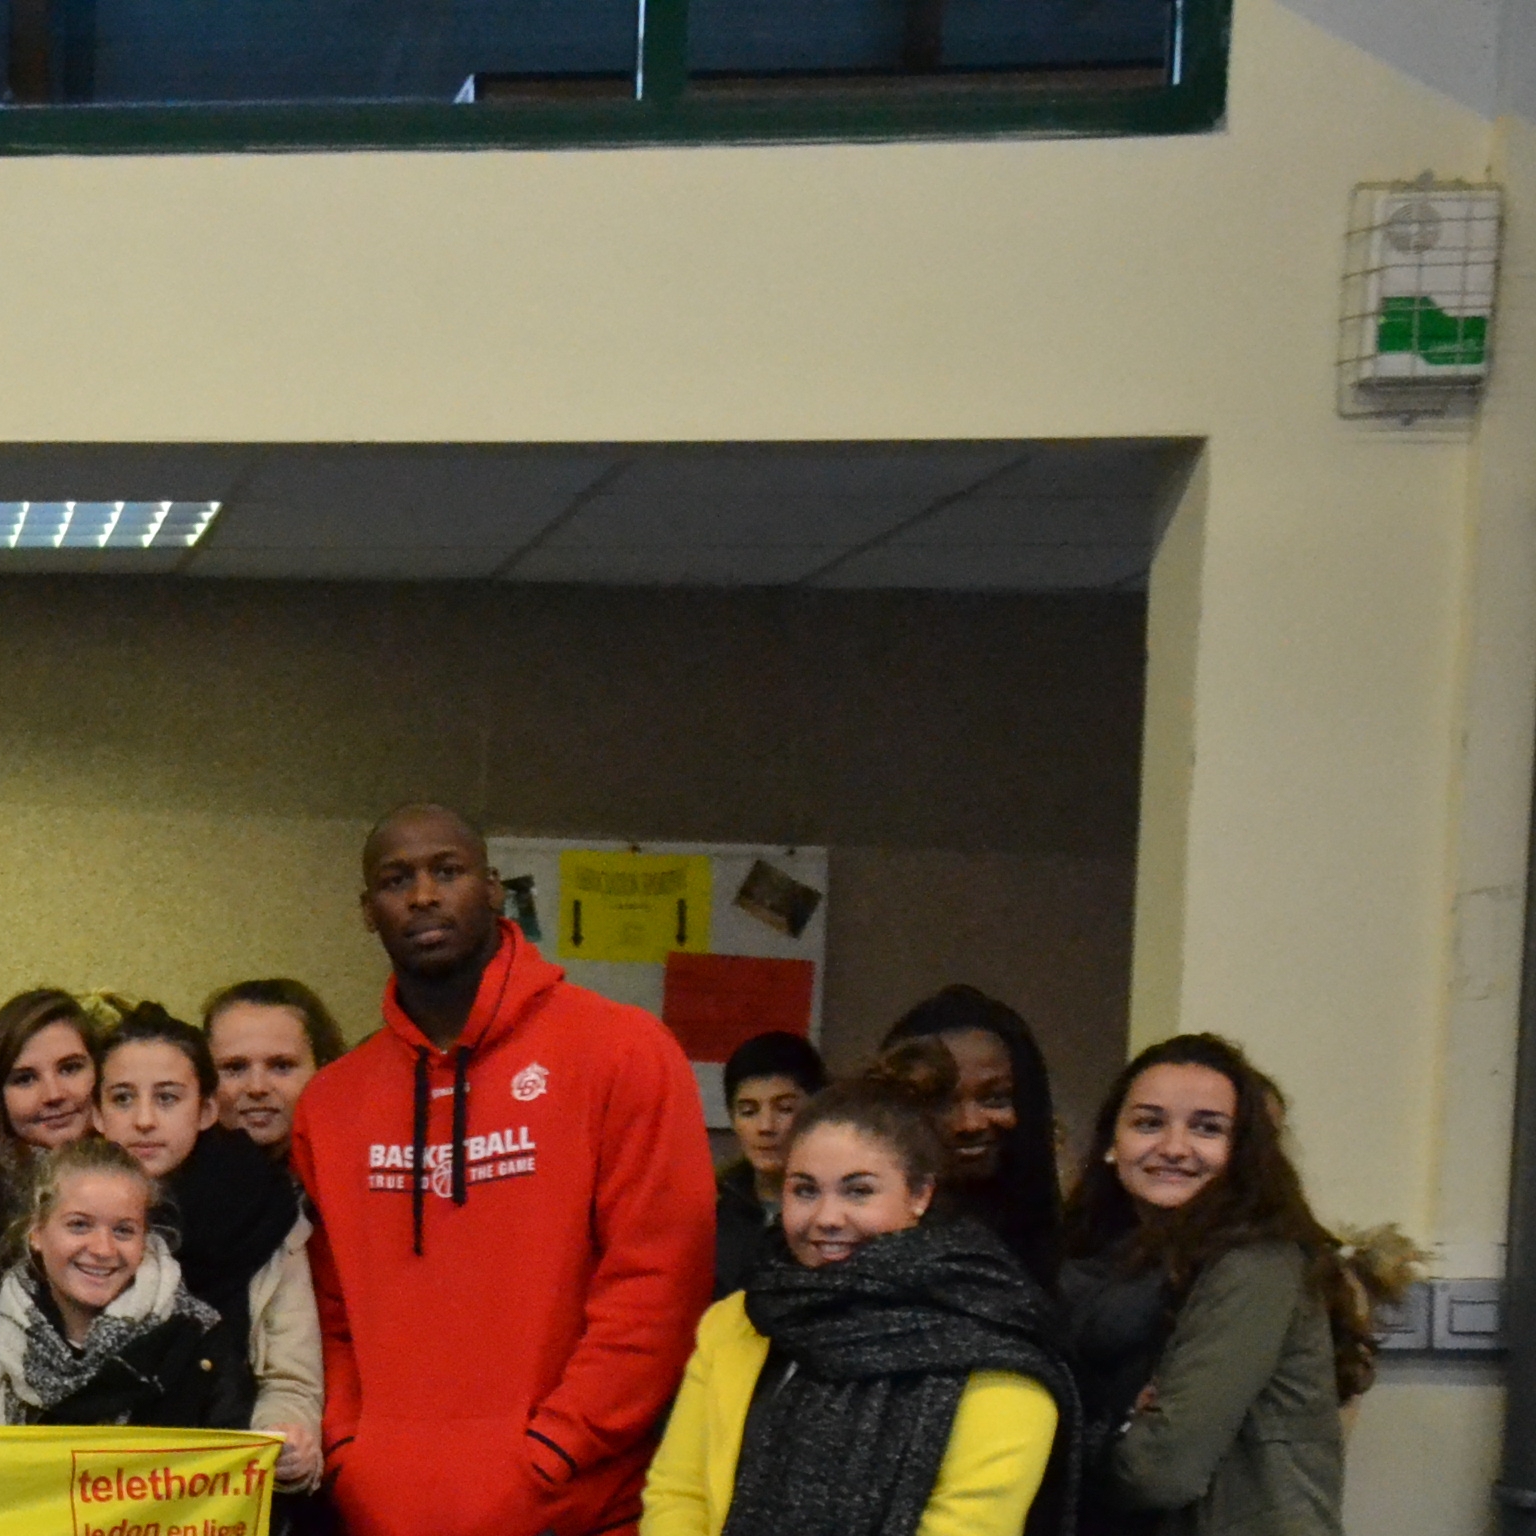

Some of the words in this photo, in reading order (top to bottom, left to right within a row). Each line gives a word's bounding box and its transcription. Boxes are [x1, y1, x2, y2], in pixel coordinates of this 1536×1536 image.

[370, 1125, 536, 1168] BASKEBALL
[368, 1175, 405, 1189] TRUE
[470, 1165, 493, 1181] THE
[499, 1157, 535, 1175] GAME
[79, 1459, 268, 1503] telethon.fr
